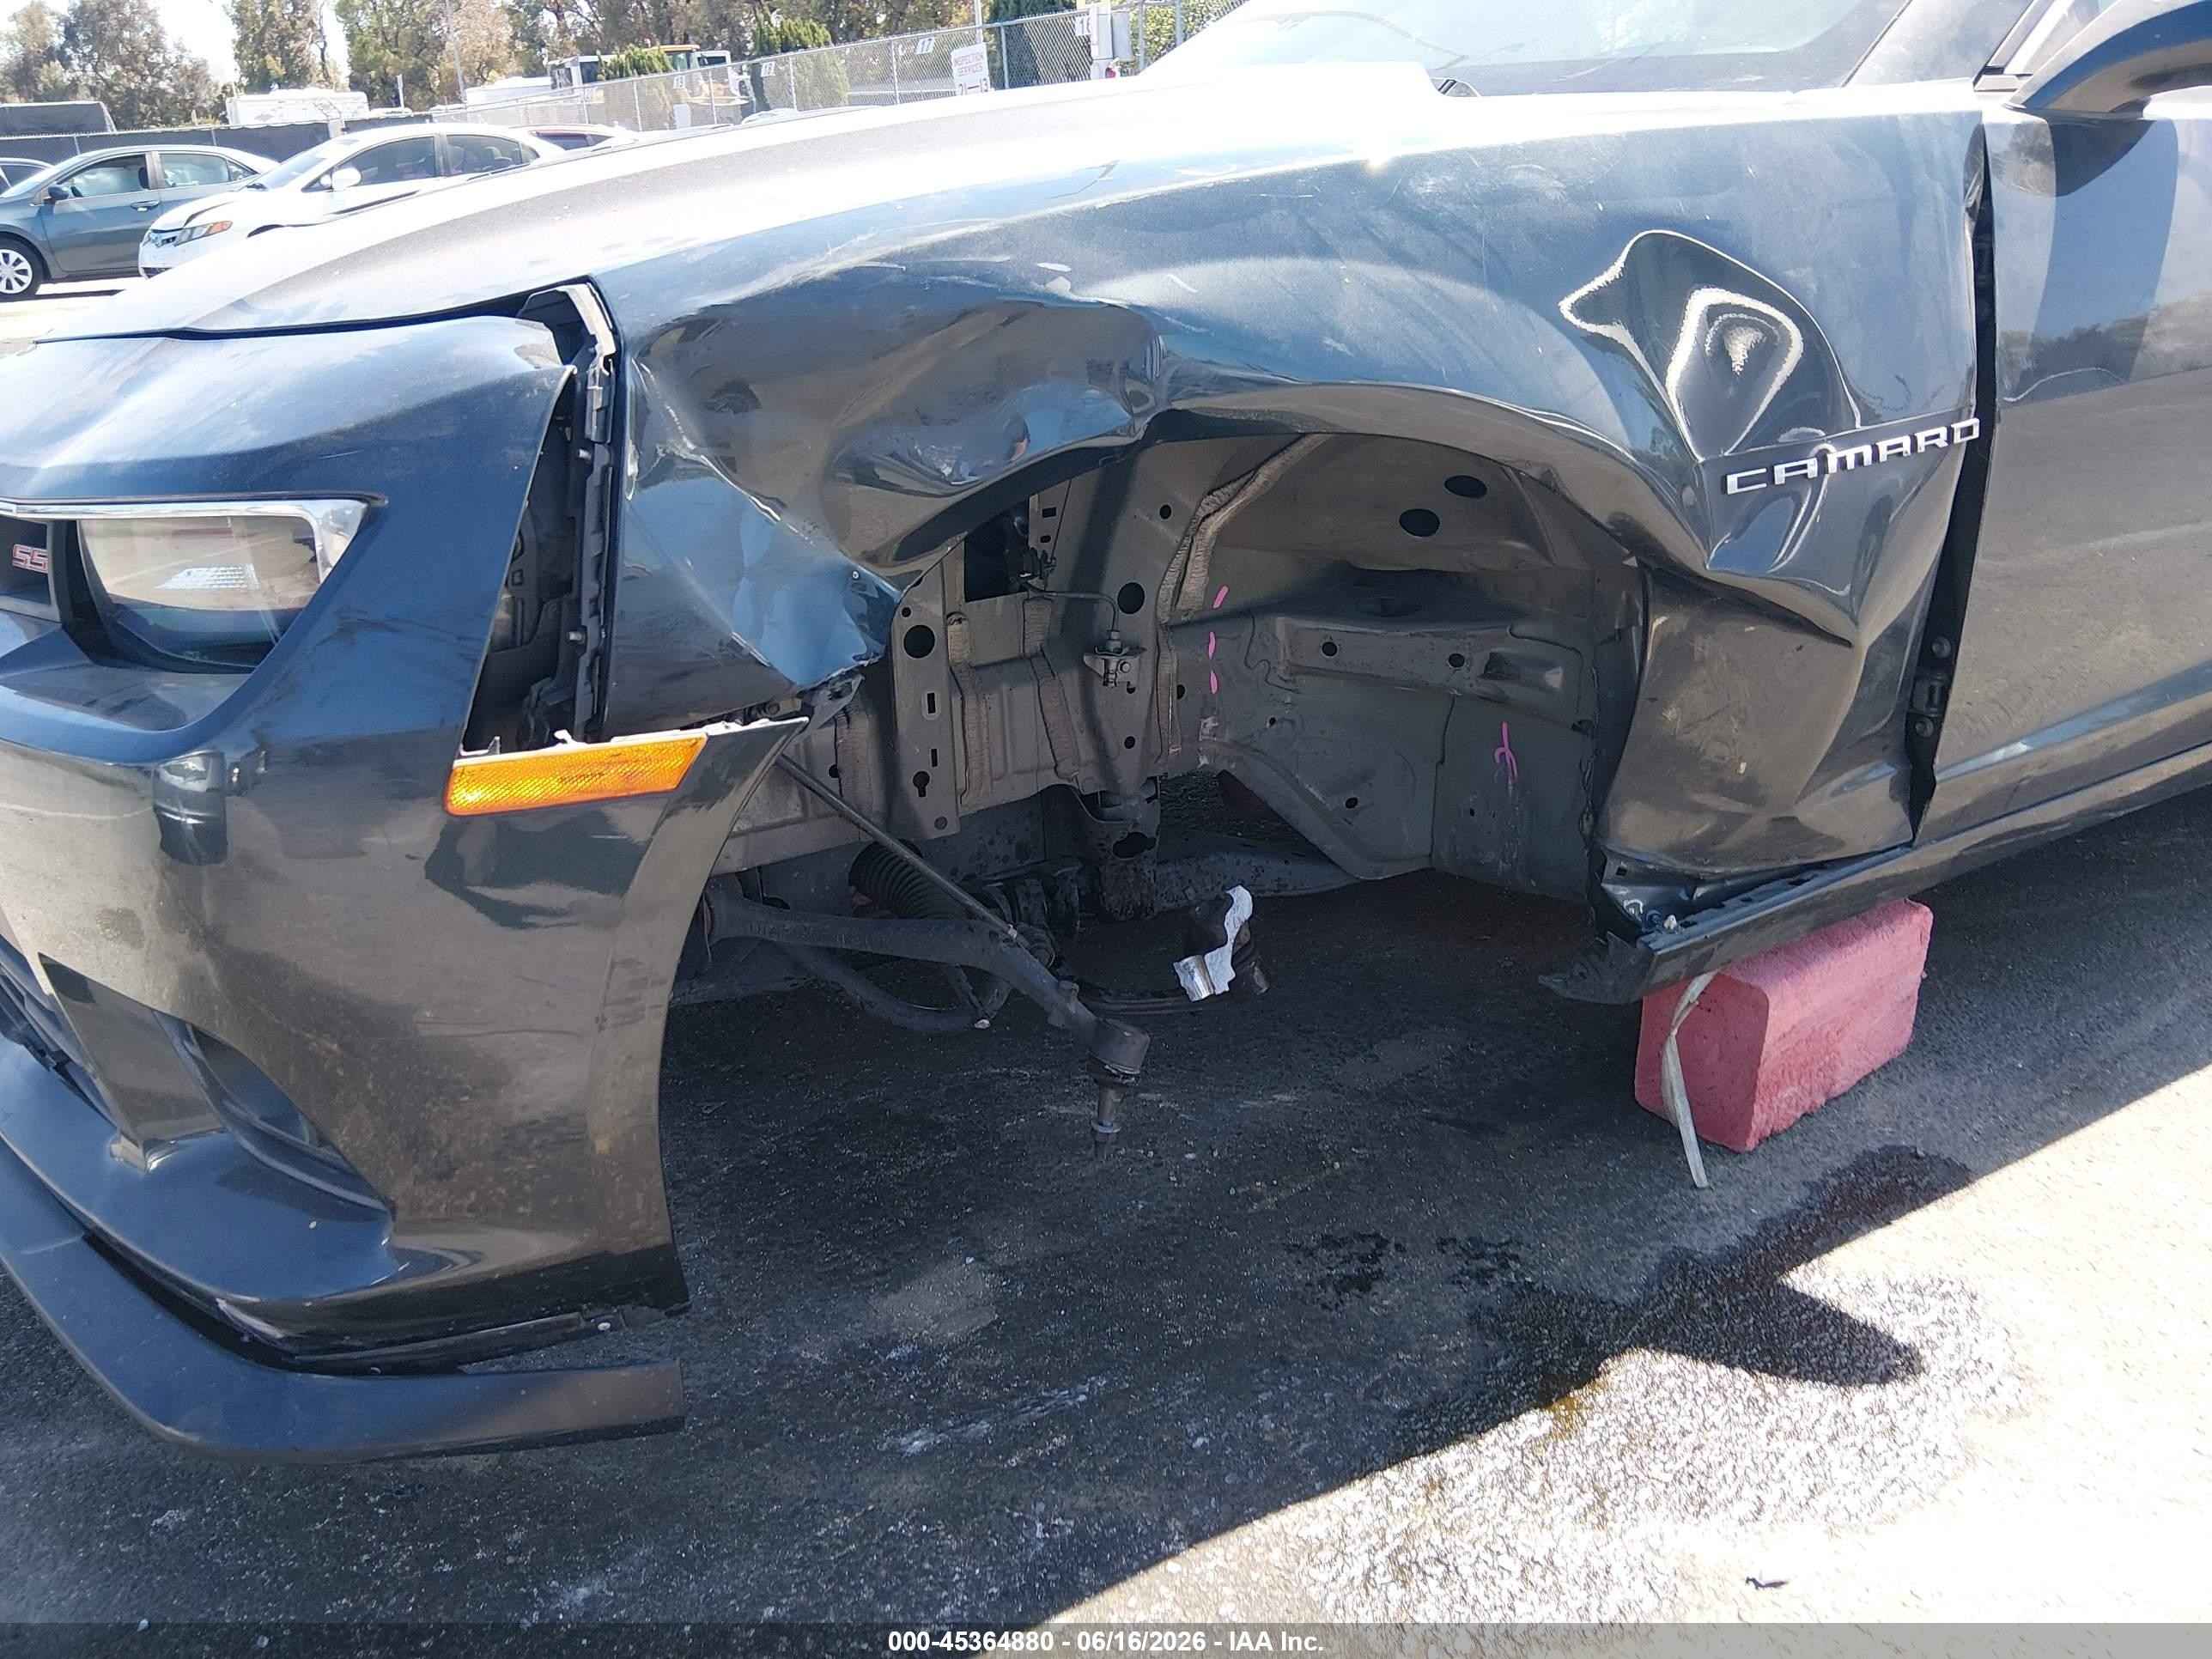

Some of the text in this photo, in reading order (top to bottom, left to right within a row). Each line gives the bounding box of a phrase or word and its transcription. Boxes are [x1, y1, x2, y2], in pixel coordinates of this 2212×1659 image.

[921, 38, 933, 53] 17
[1726, 417, 1981, 495] CAMARO
[12, 544, 49, 574] SS
